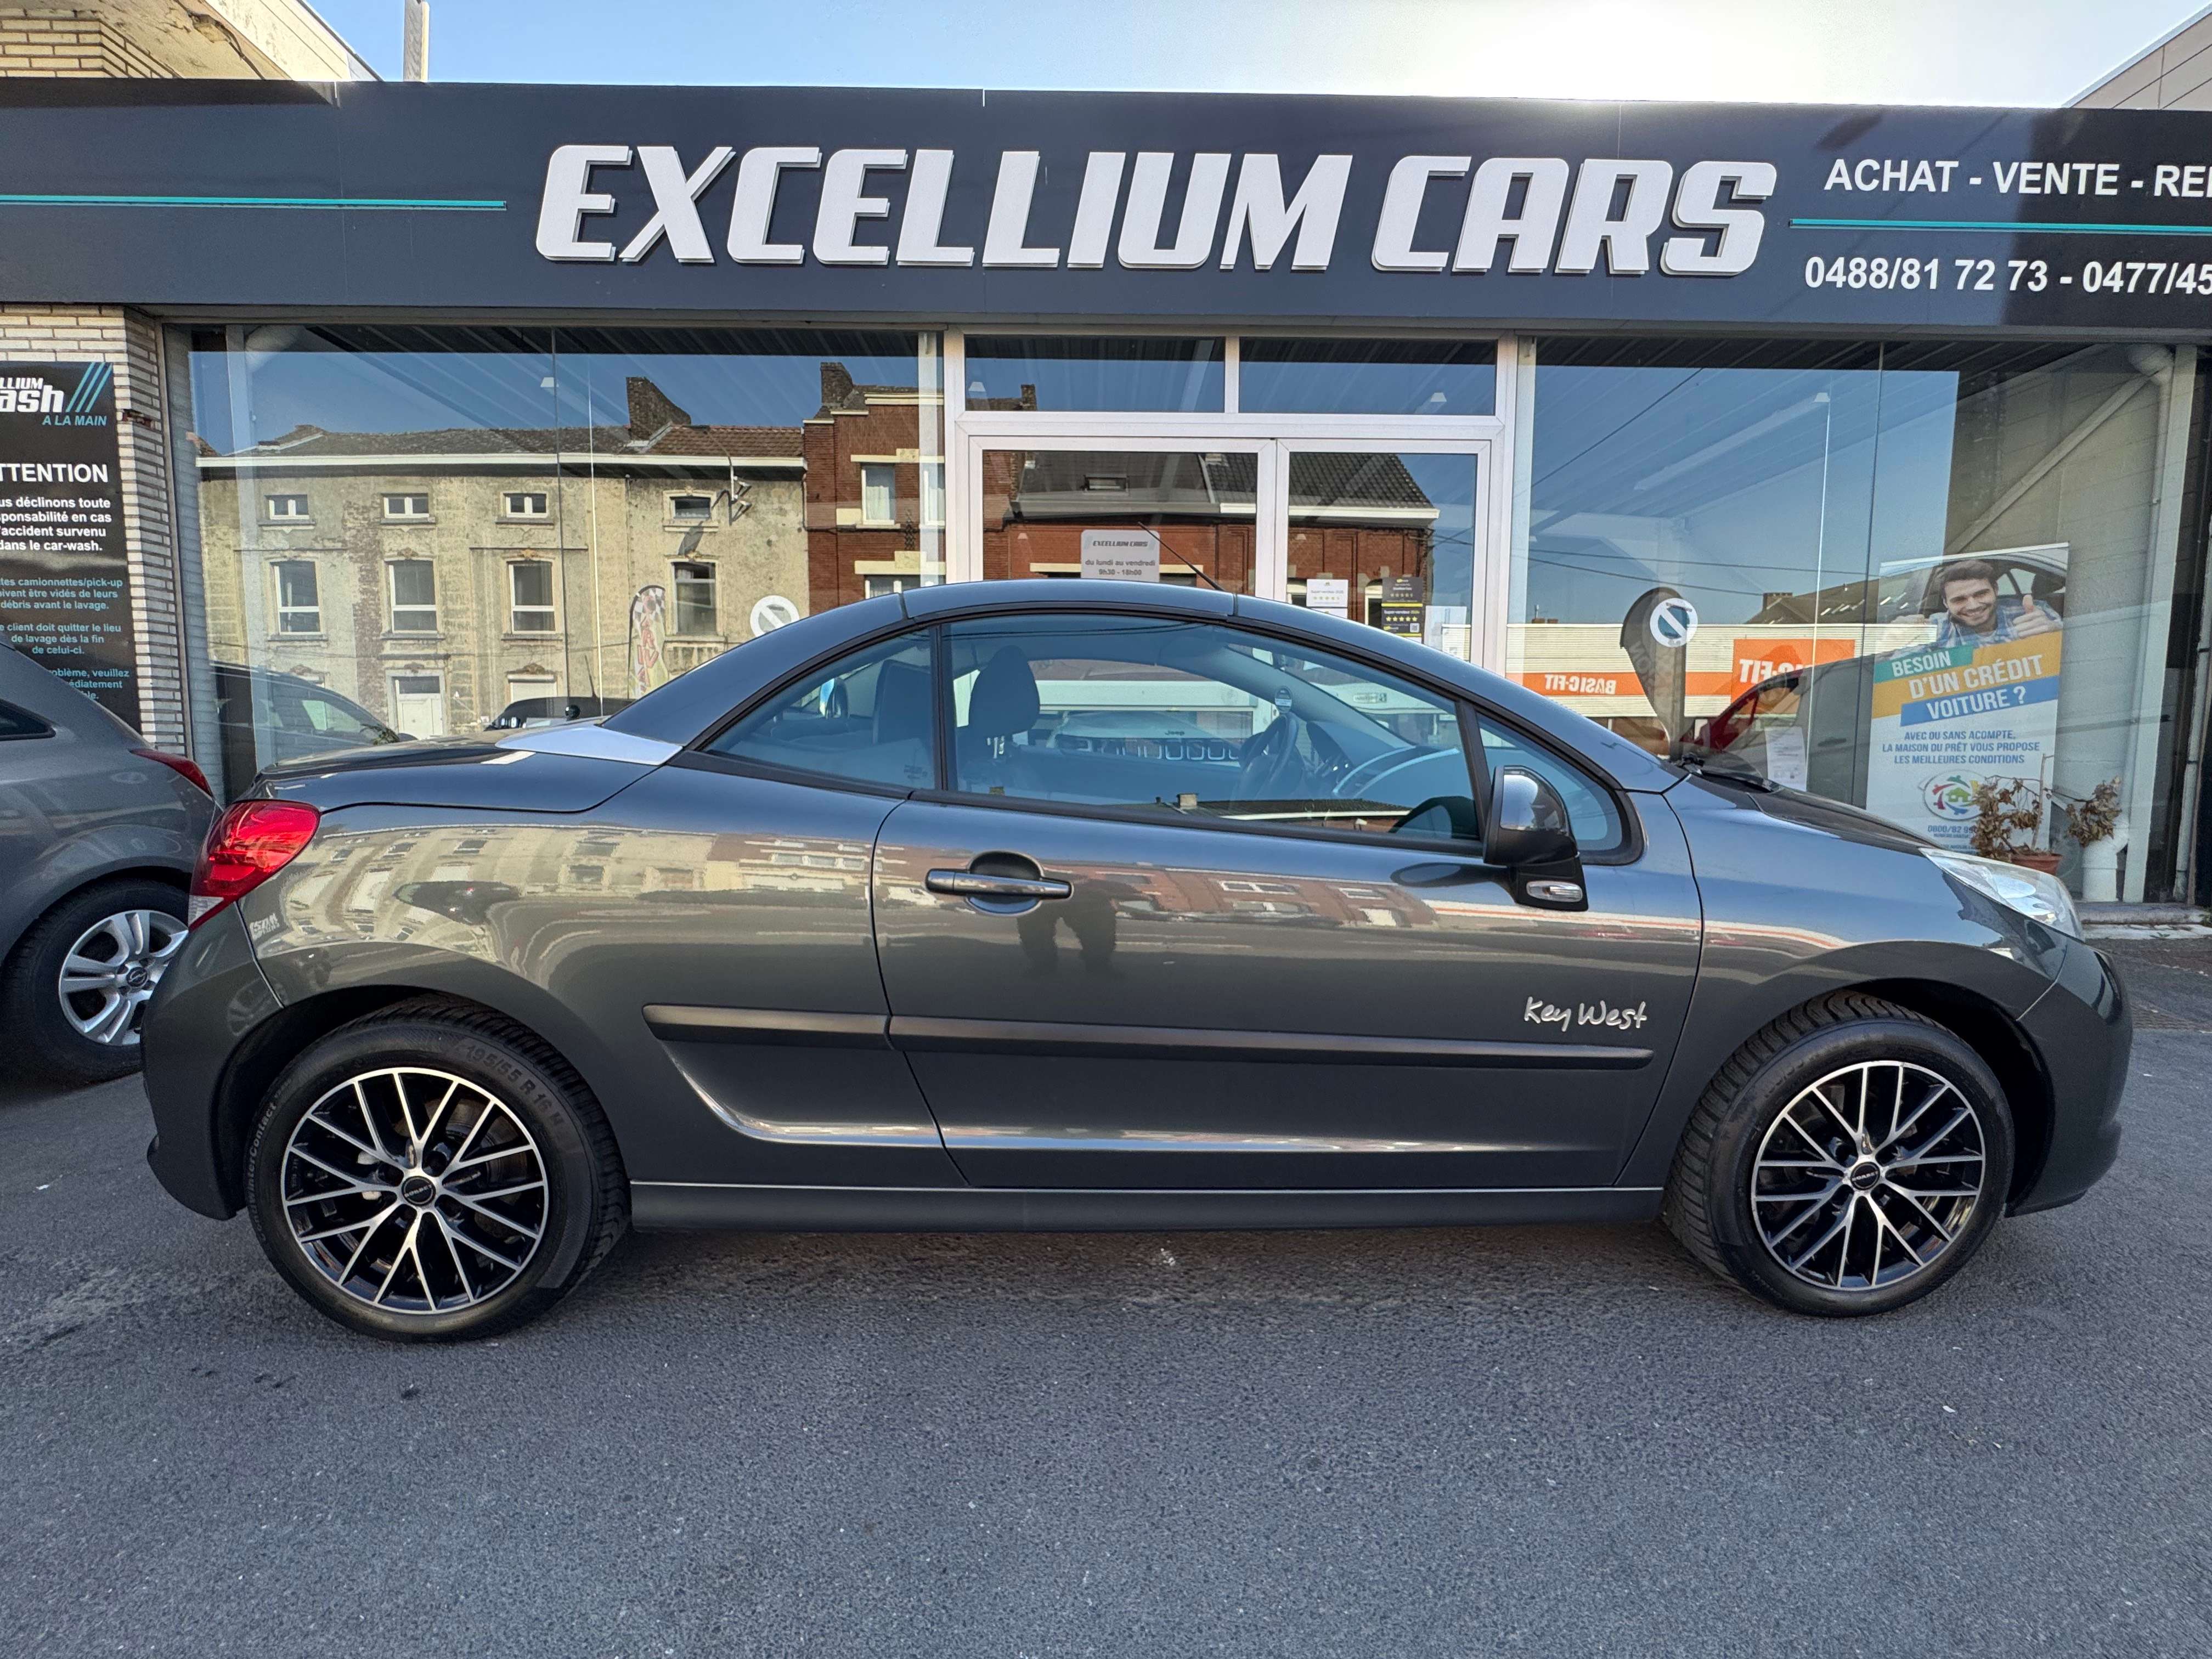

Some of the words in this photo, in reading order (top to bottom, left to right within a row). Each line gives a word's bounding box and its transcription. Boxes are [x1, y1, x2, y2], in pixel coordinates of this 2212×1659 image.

[1824, 159, 1959, 192] ACHAT
[1969, 177, 1982, 185] -
[1993, 161, 2119, 196] VENTE
[2131, 179, 2144, 188] -
[536, 145, 1353, 270] EXCELLIUM
[1372, 155, 1777, 276] CARS
[1805, 257, 1940, 290] 0488/81
[1955, 259, 1995, 291] 72
[2007, 260, 2048, 292] 73
[2059, 275, 2073, 285] -
[2082, 261, 2212, 295] 0477/45
[42, 415, 52, 426] A
[55, 415, 71, 426] LA
[75, 416, 107, 426] MAIN
[15, 496, 76, 508] déclinons
[78, 498, 111, 508] toute
[0, 511, 69, 524] ponsabilité
[71, 514, 87, 522] en
[90, 514, 112, 522] cas
[57, 528, 106, 537] survenu
[29, 540, 41, 550] le
[44, 540, 103, 551] car-wash.
[29, 589, 47, 598] être
[50, 589, 76, 598] vidés
[78, 589, 91, 598] de
[93, 589, 118, 599] leurs
[1, 600, 31, 609] débris
[33, 601, 61, 610] avant
[63, 601, 72, 609] le
[74, 601, 109, 611] lavage.
[7, 623, 33, 631] client
[36, 623, 55, 632] doit
[58, 624, 89, 634] quitter
[92, 624, 101, 632] le
[104, 624, 121, 632] lieu
[11, 634, 23, 642] de
[26, 635, 57, 645] lavage
[60, 634, 78, 643] dès
[80, 635, 89, 643] la
[92, 635, 104, 643] fin
[32, 645, 44, 654] de
[46, 646, 85, 654] celui-ci.
[1892, 651, 1951, 678] BESOIN
[92, 668, 129, 678] veuillez
[1908, 671, 1960, 699] D'UN
[1963, 654, 2043, 689] CRÉDIT
[1926, 689, 2011, 720] VOITURE
[2013, 686, 2027, 705] ?
[1904, 731, 1927, 741] AVEC
[1929, 731, 1941, 740] OU
[1942, 731, 1967, 740] SANS
[1882, 743, 1893, 752] LA
[1895, 743, 1929, 752] MAISON
[1931, 743, 1943, 752] DU
[1945, 741, 1968, 752] PRÊT
[1970, 742, 1995, 752] VOUS
[1996, 742, 2040, 751] PROPOSE
[1894, 755, 1910, 764] LES
[1912, 754, 1967, 764] MEILLEURES
[1968, 754, 2025, 764] CONDITIONS
[1523, 996, 1571, 1032] Key
[1578, 1000, 1647, 1030] West
